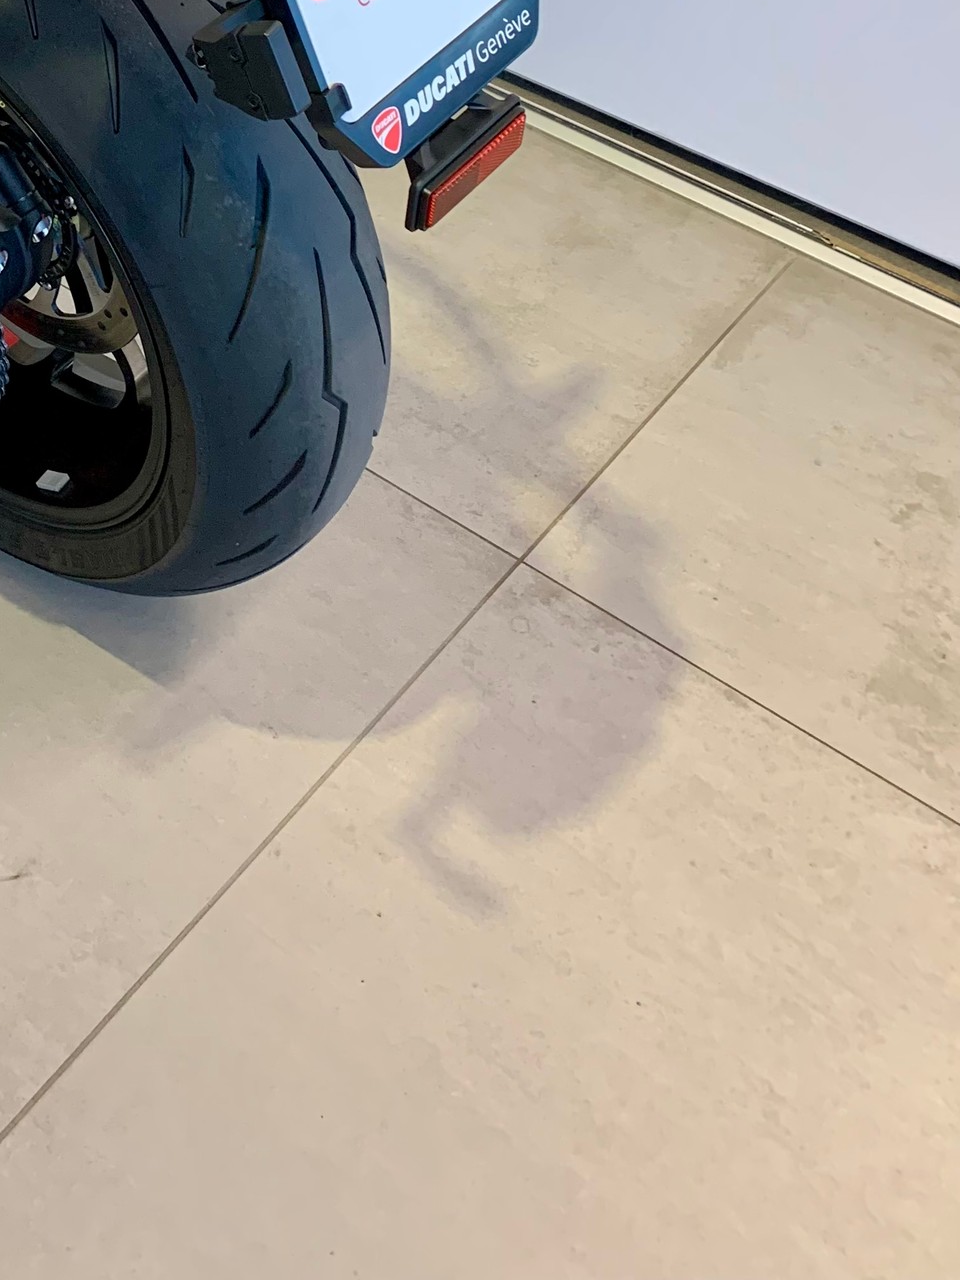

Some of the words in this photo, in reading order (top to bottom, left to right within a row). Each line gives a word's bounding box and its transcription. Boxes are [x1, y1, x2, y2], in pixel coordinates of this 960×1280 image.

[403, 49, 476, 127] DUCATI
[476, 9, 532, 63] Genève
[374, 111, 397, 133] DUCATI
